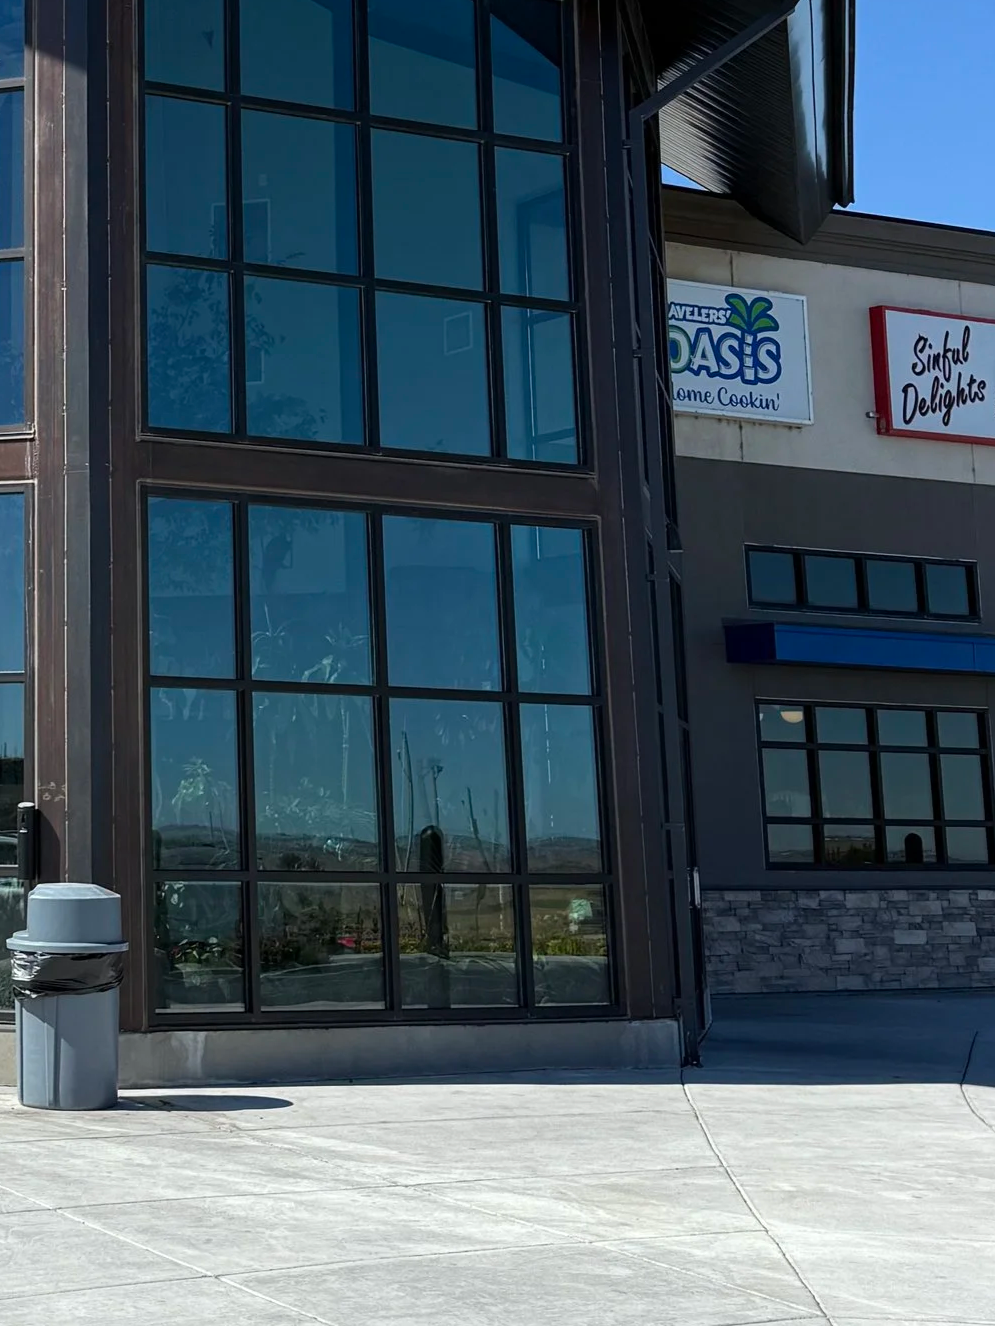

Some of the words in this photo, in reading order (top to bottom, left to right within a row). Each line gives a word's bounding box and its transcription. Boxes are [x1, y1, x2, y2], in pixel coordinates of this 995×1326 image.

[668, 303, 732, 325] AVELERS'
[912, 325, 970, 383] Sinful
[672, 387, 715, 405] ome
[717, 386, 780, 411] Cookin'
[902, 371, 986, 426] Delights
